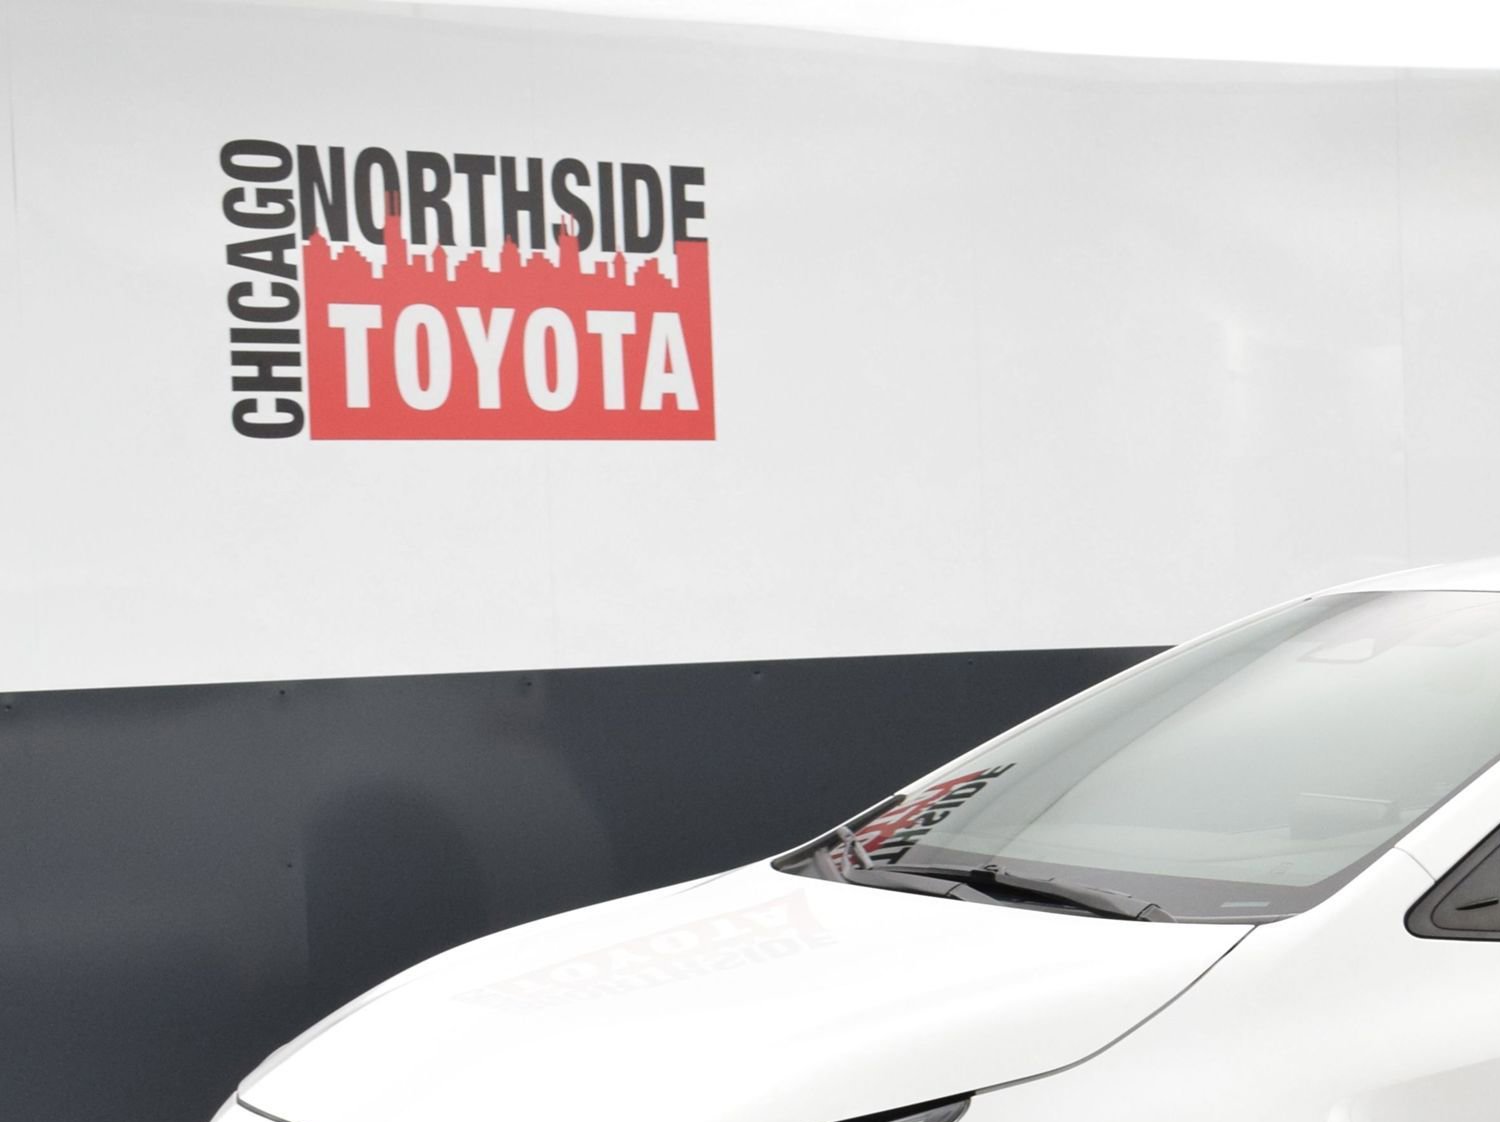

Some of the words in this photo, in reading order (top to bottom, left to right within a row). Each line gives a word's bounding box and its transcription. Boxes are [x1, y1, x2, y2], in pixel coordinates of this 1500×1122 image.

[296, 144, 709, 255] NORTHSIDE
[219, 138, 305, 439] CHICAGO
[327, 303, 700, 412] TOYOTA
